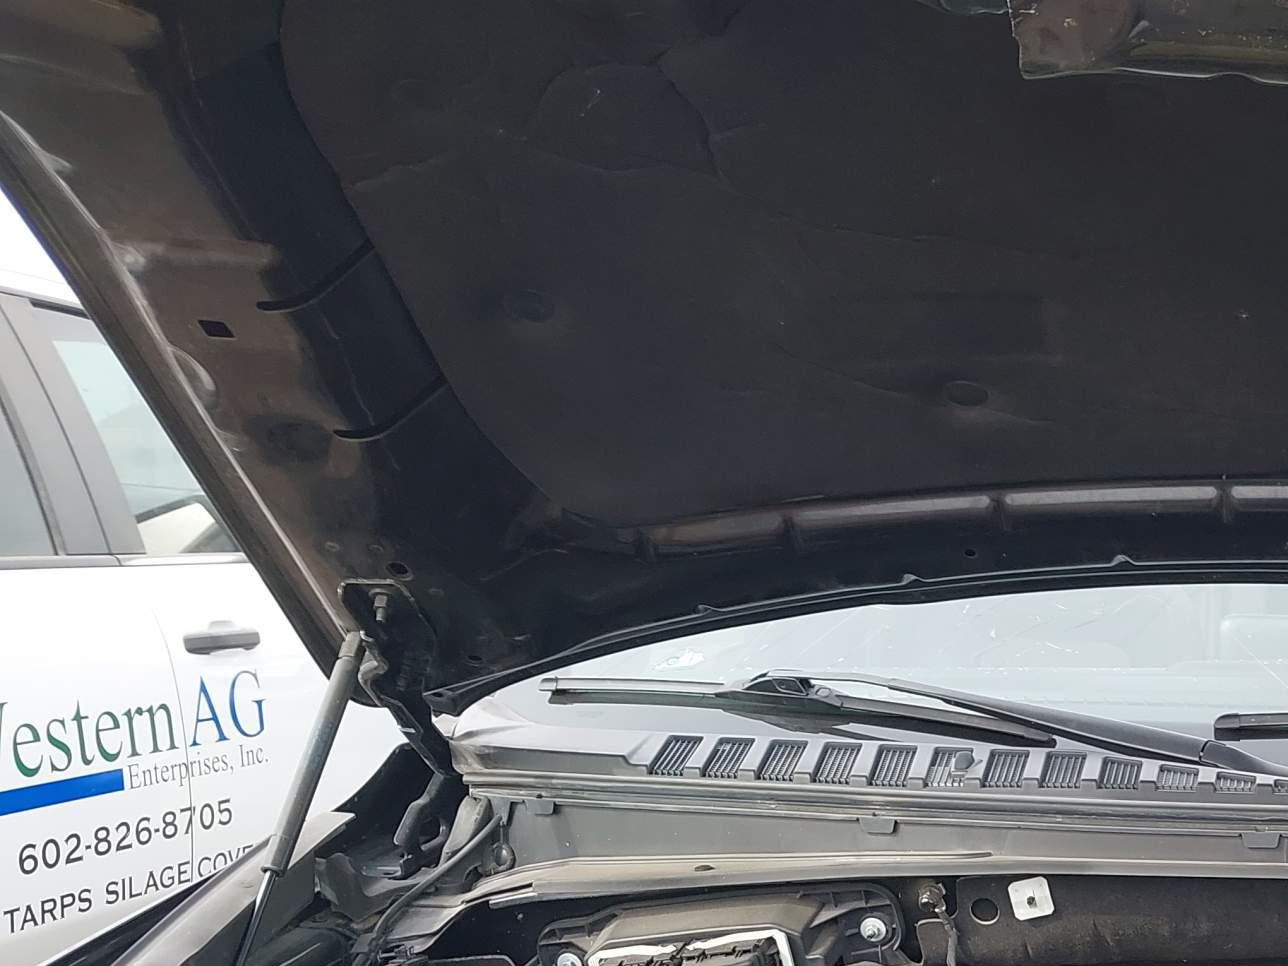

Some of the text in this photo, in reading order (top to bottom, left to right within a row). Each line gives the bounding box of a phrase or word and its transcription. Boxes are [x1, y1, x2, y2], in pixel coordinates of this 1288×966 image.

[0, 669, 267, 778] estern AG
[128, 744, 269, 790] Enterprises, Inc.
[18, 799, 233, 875] 602-826-8705
[4, 844, 254, 934] TARPS SILAGE COV
